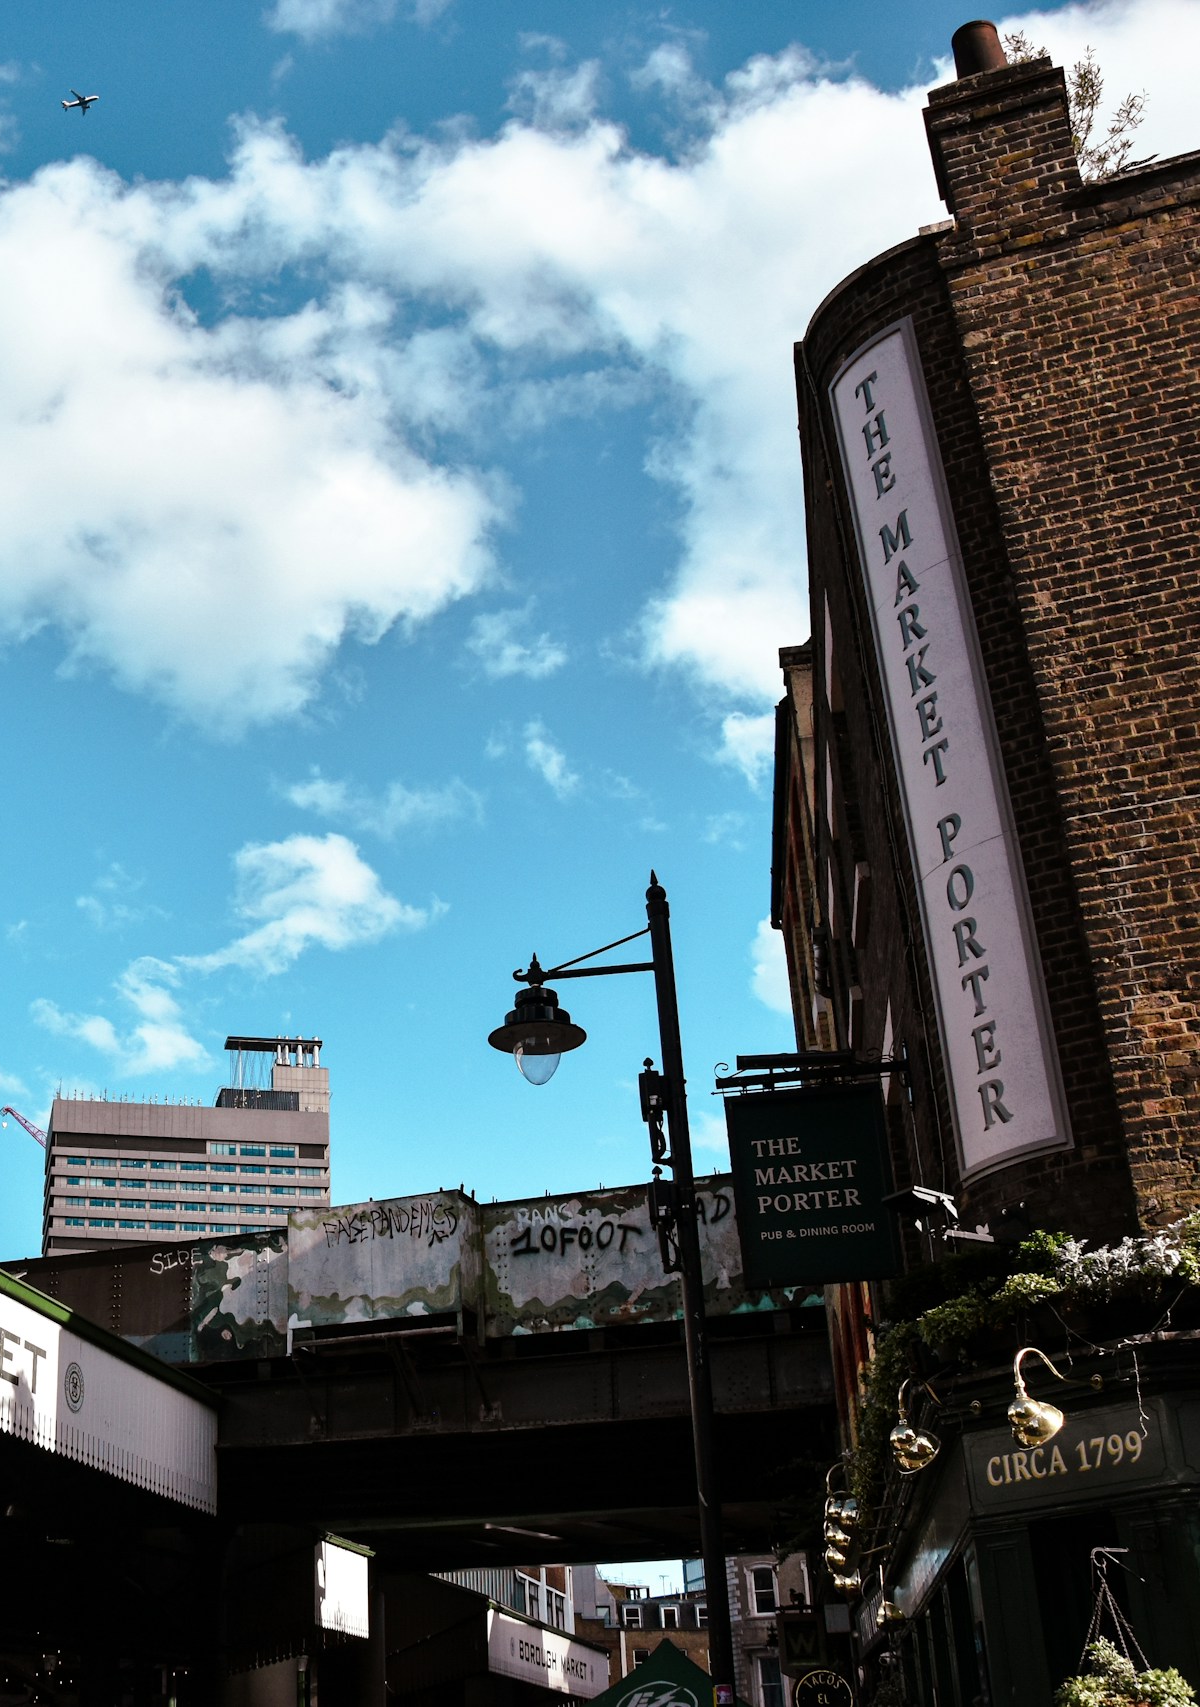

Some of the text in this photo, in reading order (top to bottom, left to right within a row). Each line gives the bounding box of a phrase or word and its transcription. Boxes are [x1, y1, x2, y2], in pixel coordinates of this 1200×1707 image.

[855, 371, 1014, 1131] THE MARKET PORTER
[751, 1137, 801, 1157] THE
[754, 1160, 856, 1186] MARKET
[758, 1188, 861, 1214] PORTER
[510, 1221, 642, 1257] 10FOOT
[761, 1223, 875, 1240] PUB & DINING ROOM
[150, 1247, 203, 1275] SIDE
[986, 1430, 1143, 1486] CIRCA 1799
[519, 1640, 586, 1681] BOROUGH MARKET
[803, 1672, 843, 1689] TACOS
